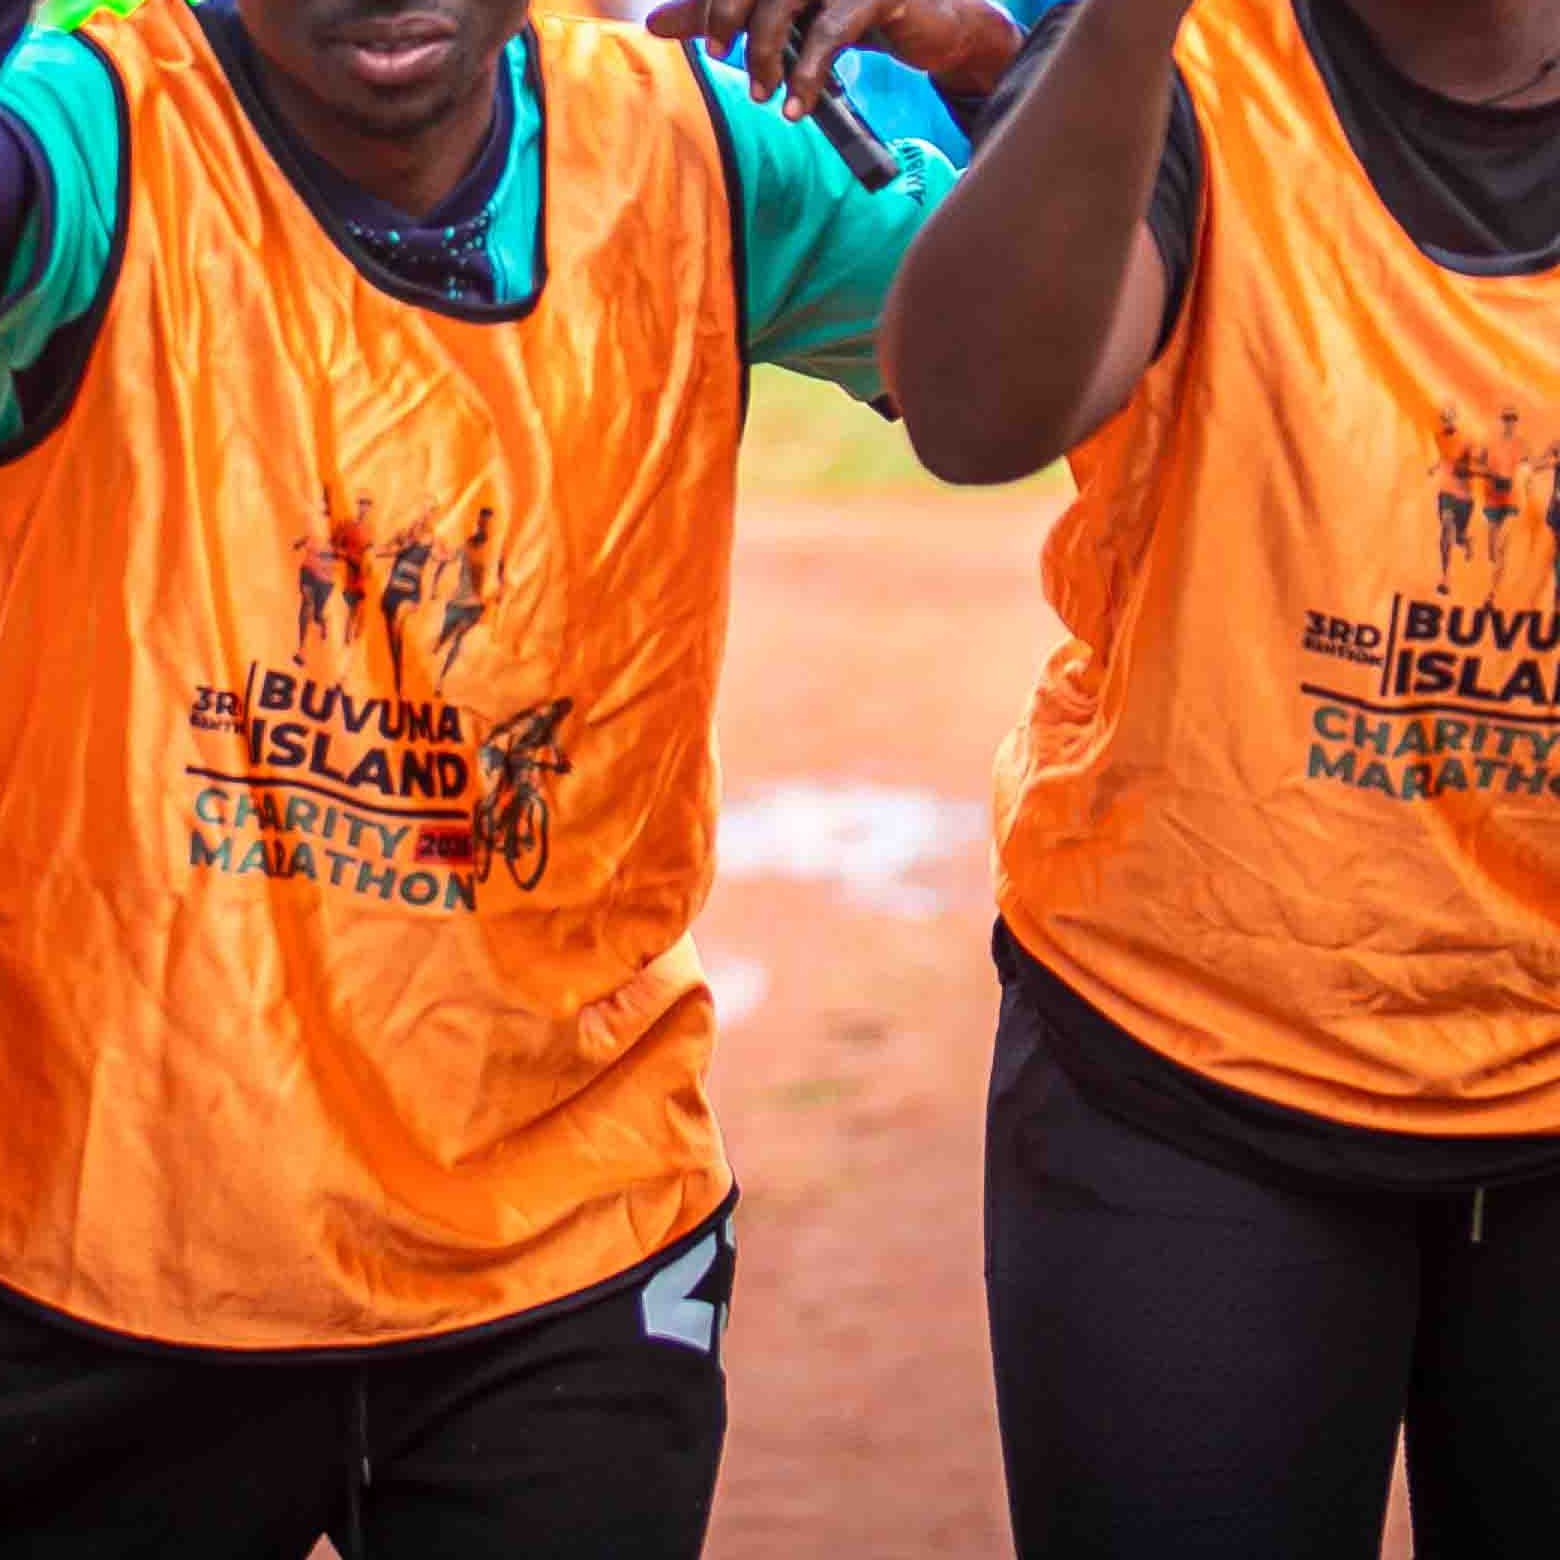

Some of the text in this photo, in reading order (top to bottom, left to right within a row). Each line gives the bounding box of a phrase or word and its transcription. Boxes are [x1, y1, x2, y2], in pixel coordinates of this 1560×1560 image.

[1303, 609, 1382, 649] 3RD
[192, 685, 240, 717] 3R
[259, 670, 465, 745] BUVUMA
[249, 719, 468, 800] ISLAND
